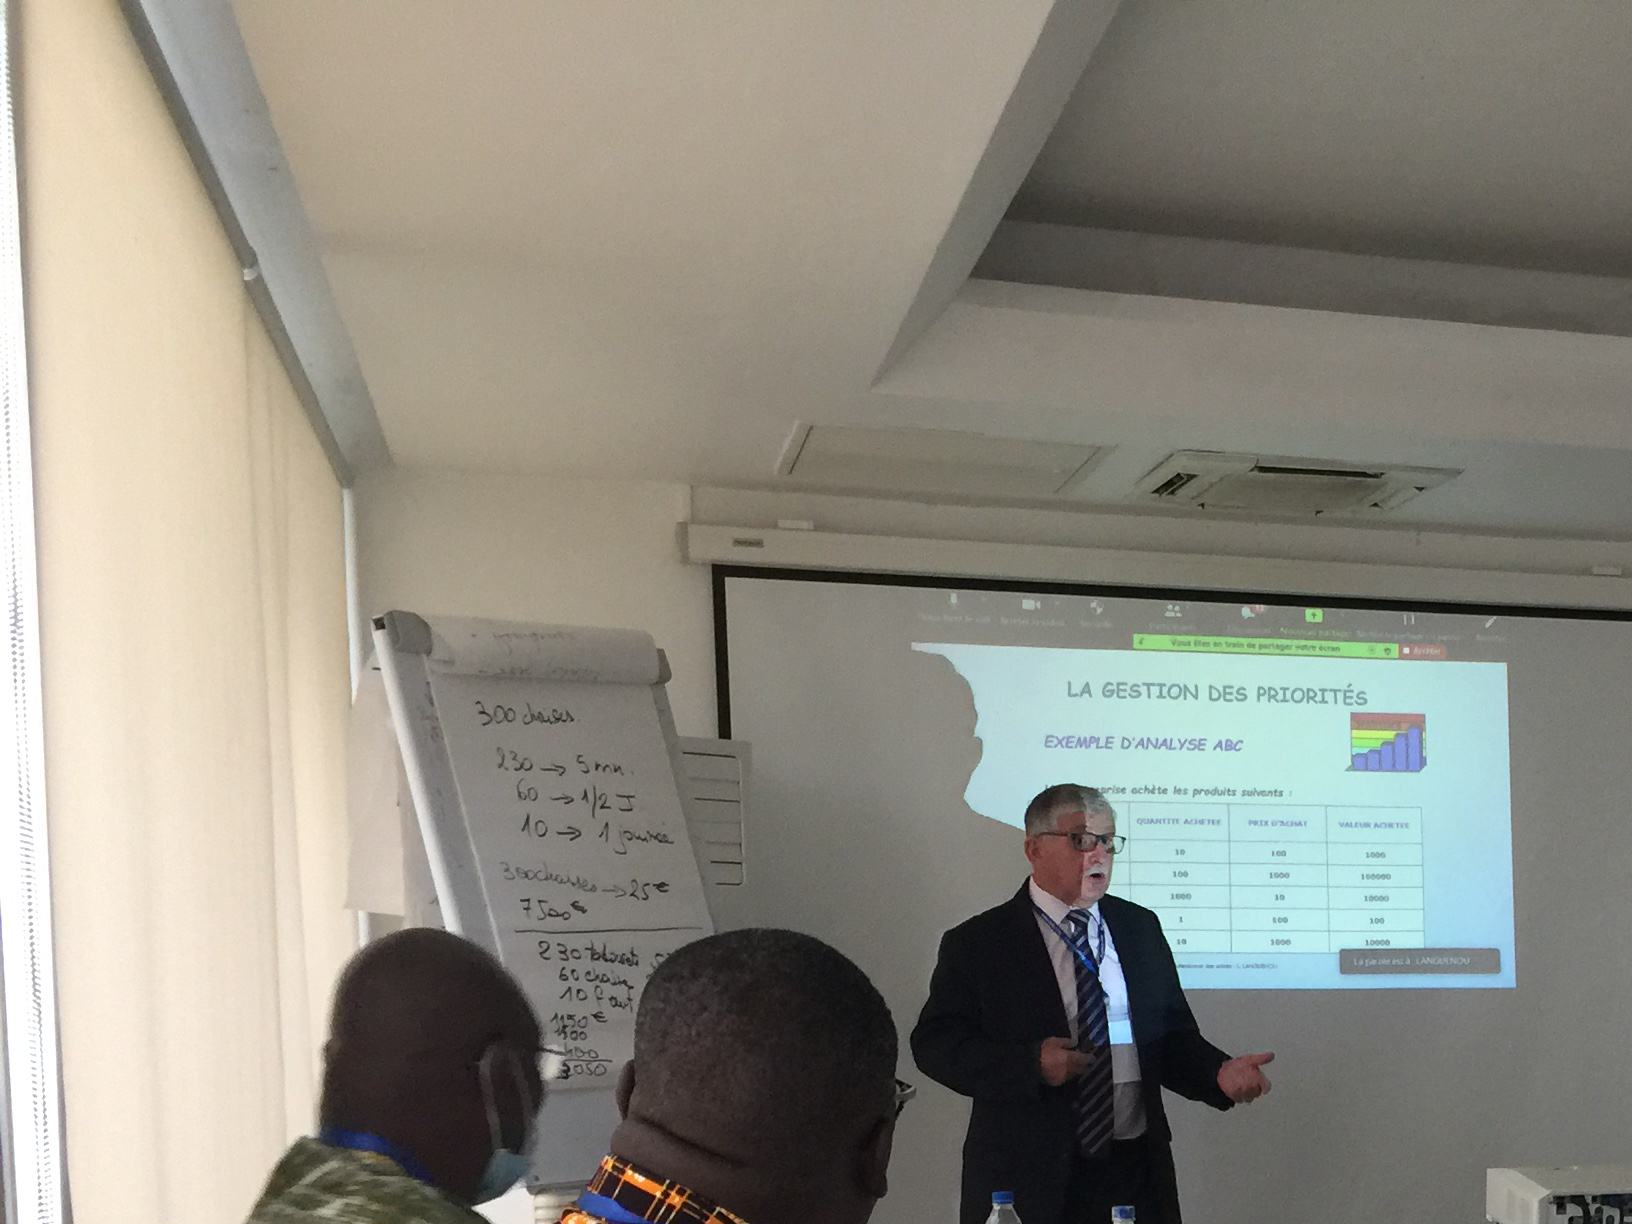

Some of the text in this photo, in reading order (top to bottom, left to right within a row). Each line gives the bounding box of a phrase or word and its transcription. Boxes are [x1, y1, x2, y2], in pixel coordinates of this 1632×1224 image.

[1225, 640, 1244, 649] train
[1246, 641, 1256, 649] de
[1258, 642, 1292, 652] partager
[1067, 681, 1368, 706] LA GESTION DES PRIORITÉS
[475, 701, 517, 726] 300
[1043, 734, 1244, 753] EXEMPLE D'ANALYSE ABC
[496, 747, 534, 772] 230
[515, 777, 539, 802] 60
[1131, 784, 1168, 795] achète
[1173, 785, 1188, 796] les
[1192, 786, 1237, 799] produits
[1241, 787, 1284, 798] suivants
[521, 813, 548, 838] 10
[1248, 819, 1269, 827] PRIX
[1338, 821, 1373, 829] VALEUR
[1368, 917, 1386, 925] 100
[559, 986, 588, 1002] 10
